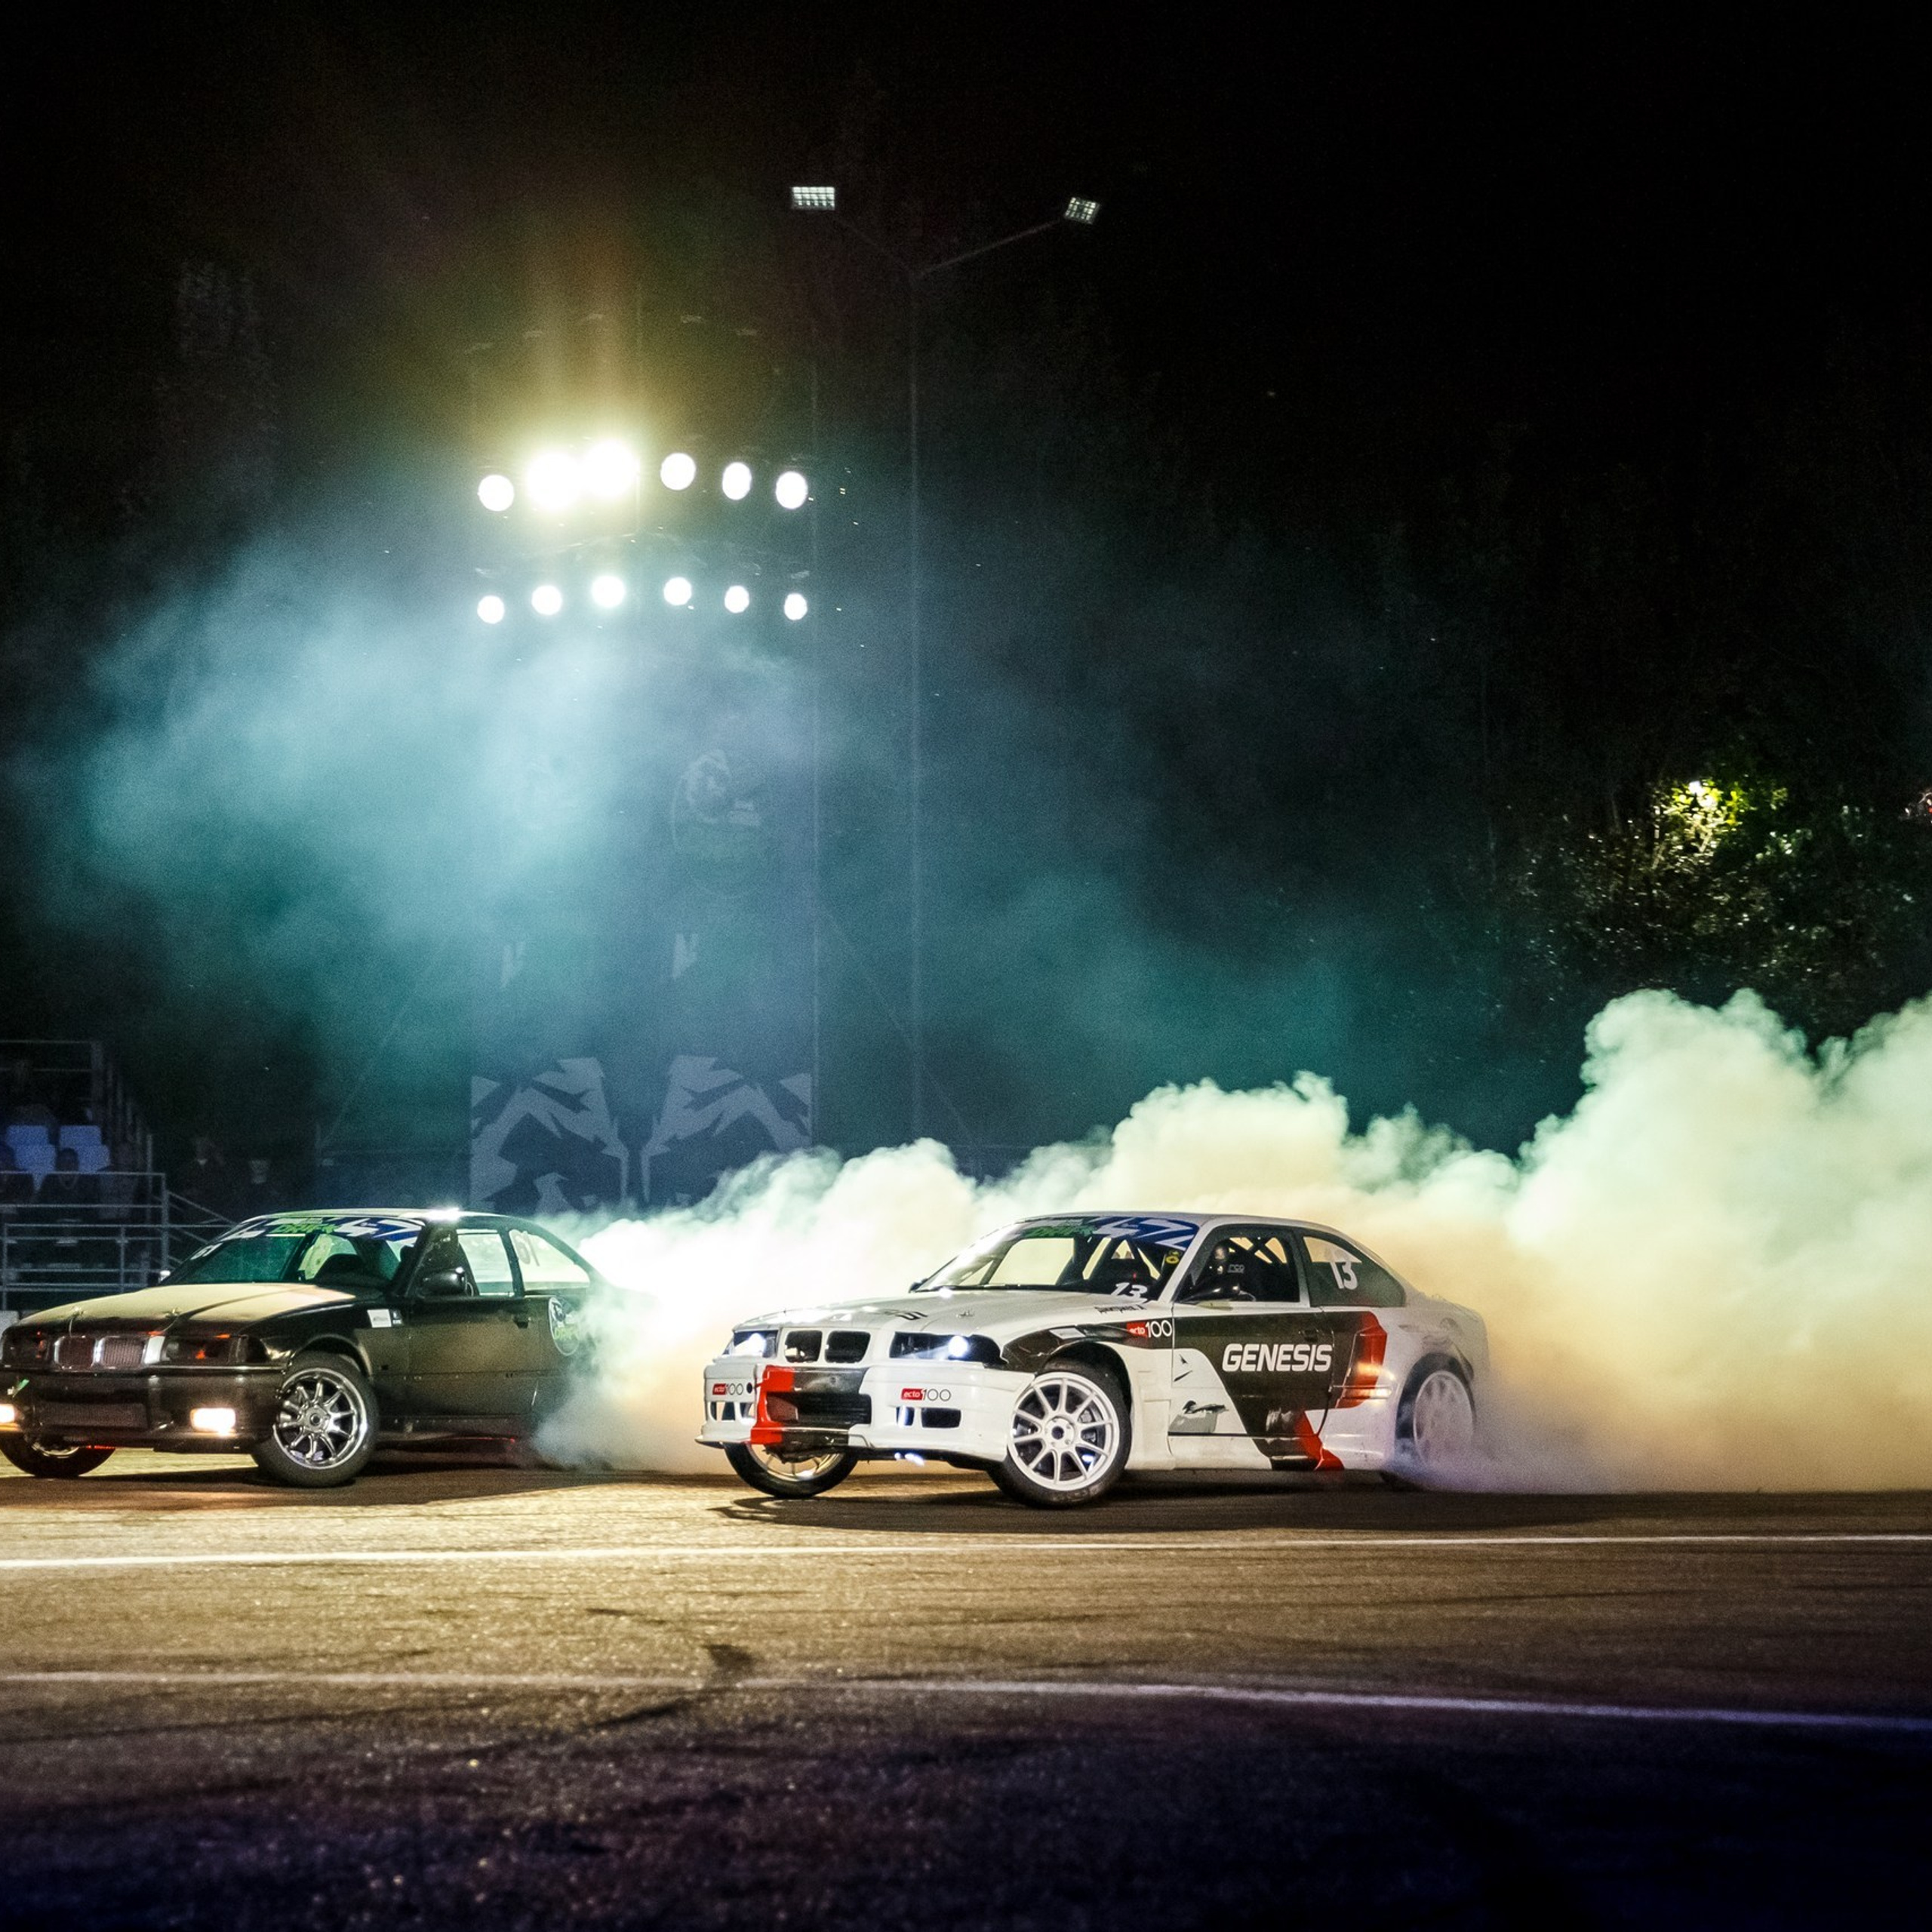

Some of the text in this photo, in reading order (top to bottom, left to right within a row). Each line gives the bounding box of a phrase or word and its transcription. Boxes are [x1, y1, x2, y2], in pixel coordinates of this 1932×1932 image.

[1326, 1248, 1358, 1290] 13
[1110, 1281, 1148, 1303] 13
[1222, 1343, 1333, 1372] GENESIS
